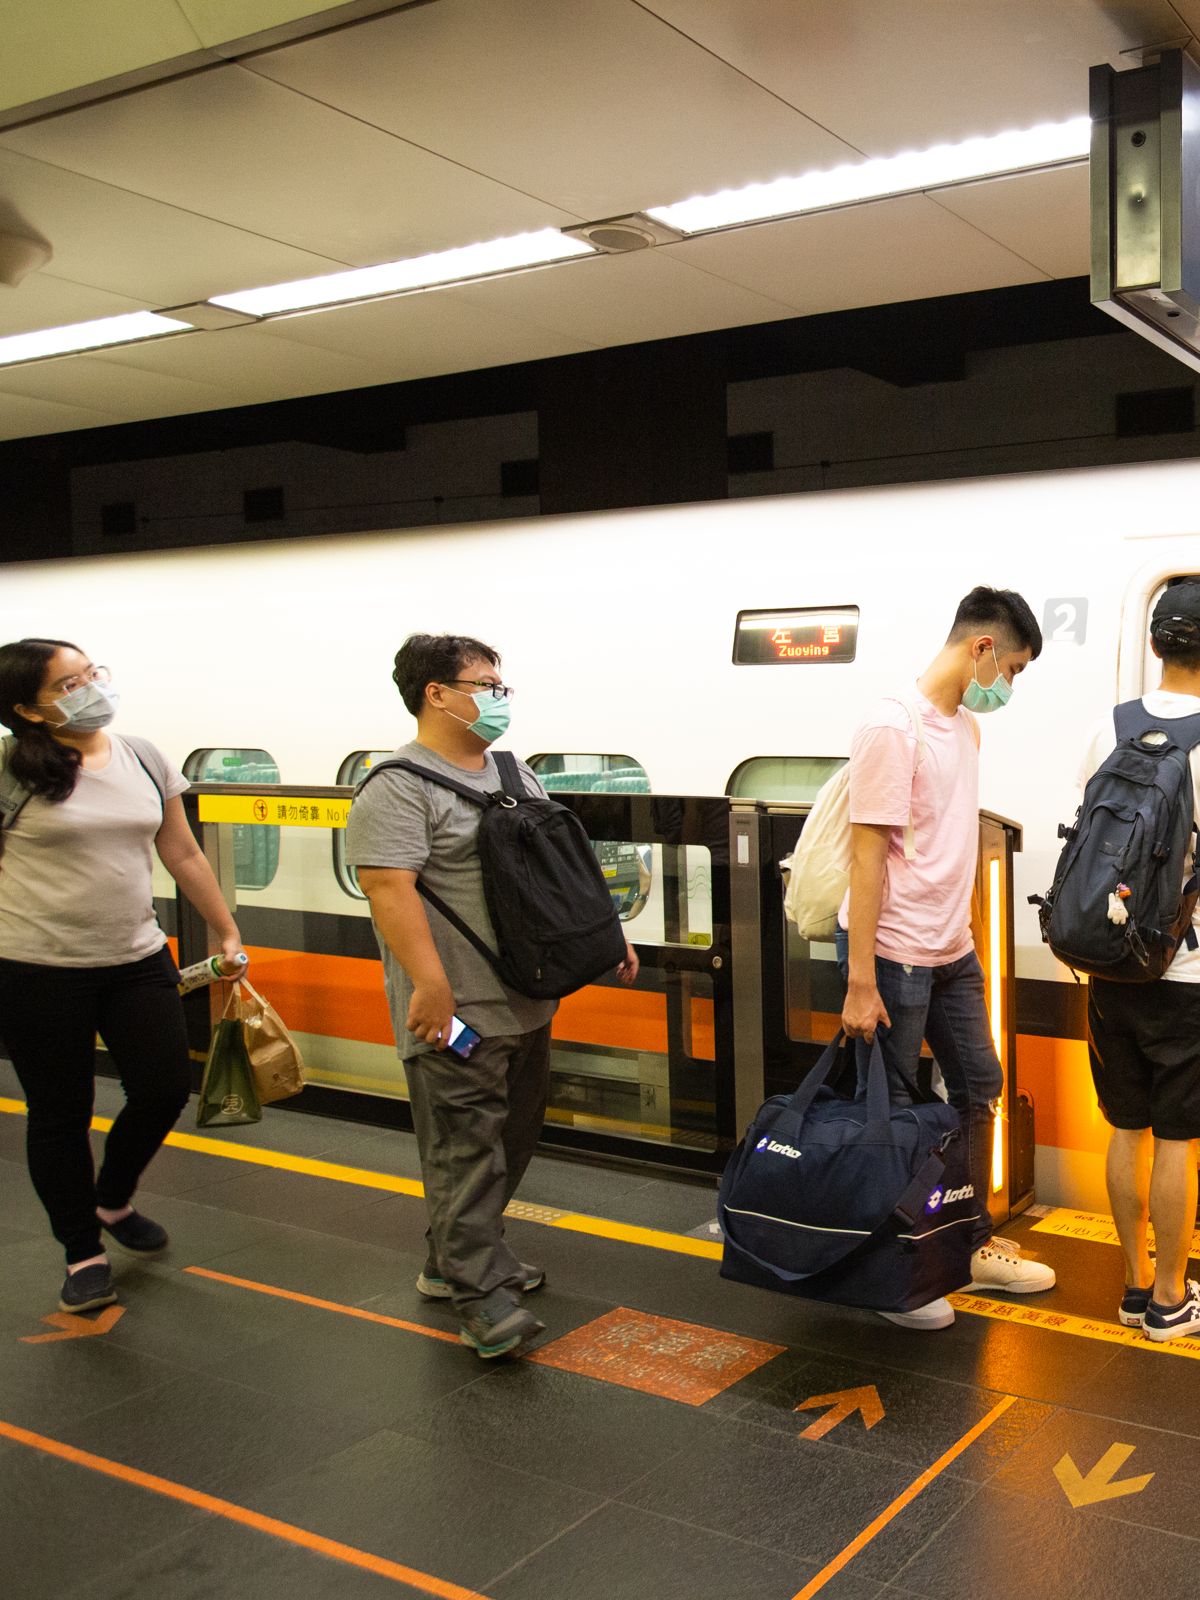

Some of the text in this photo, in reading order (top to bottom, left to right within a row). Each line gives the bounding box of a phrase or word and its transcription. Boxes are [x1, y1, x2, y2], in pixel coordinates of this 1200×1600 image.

[1053, 603, 1077, 641] 2
[778, 645, 830, 657] Zuoying
[277, 804, 320, 820] 請勿倚靠
[327, 808, 340, 821] No
[1082, 1322, 1100, 1332] Do
[1103, 1327, 1126, 1337] not
